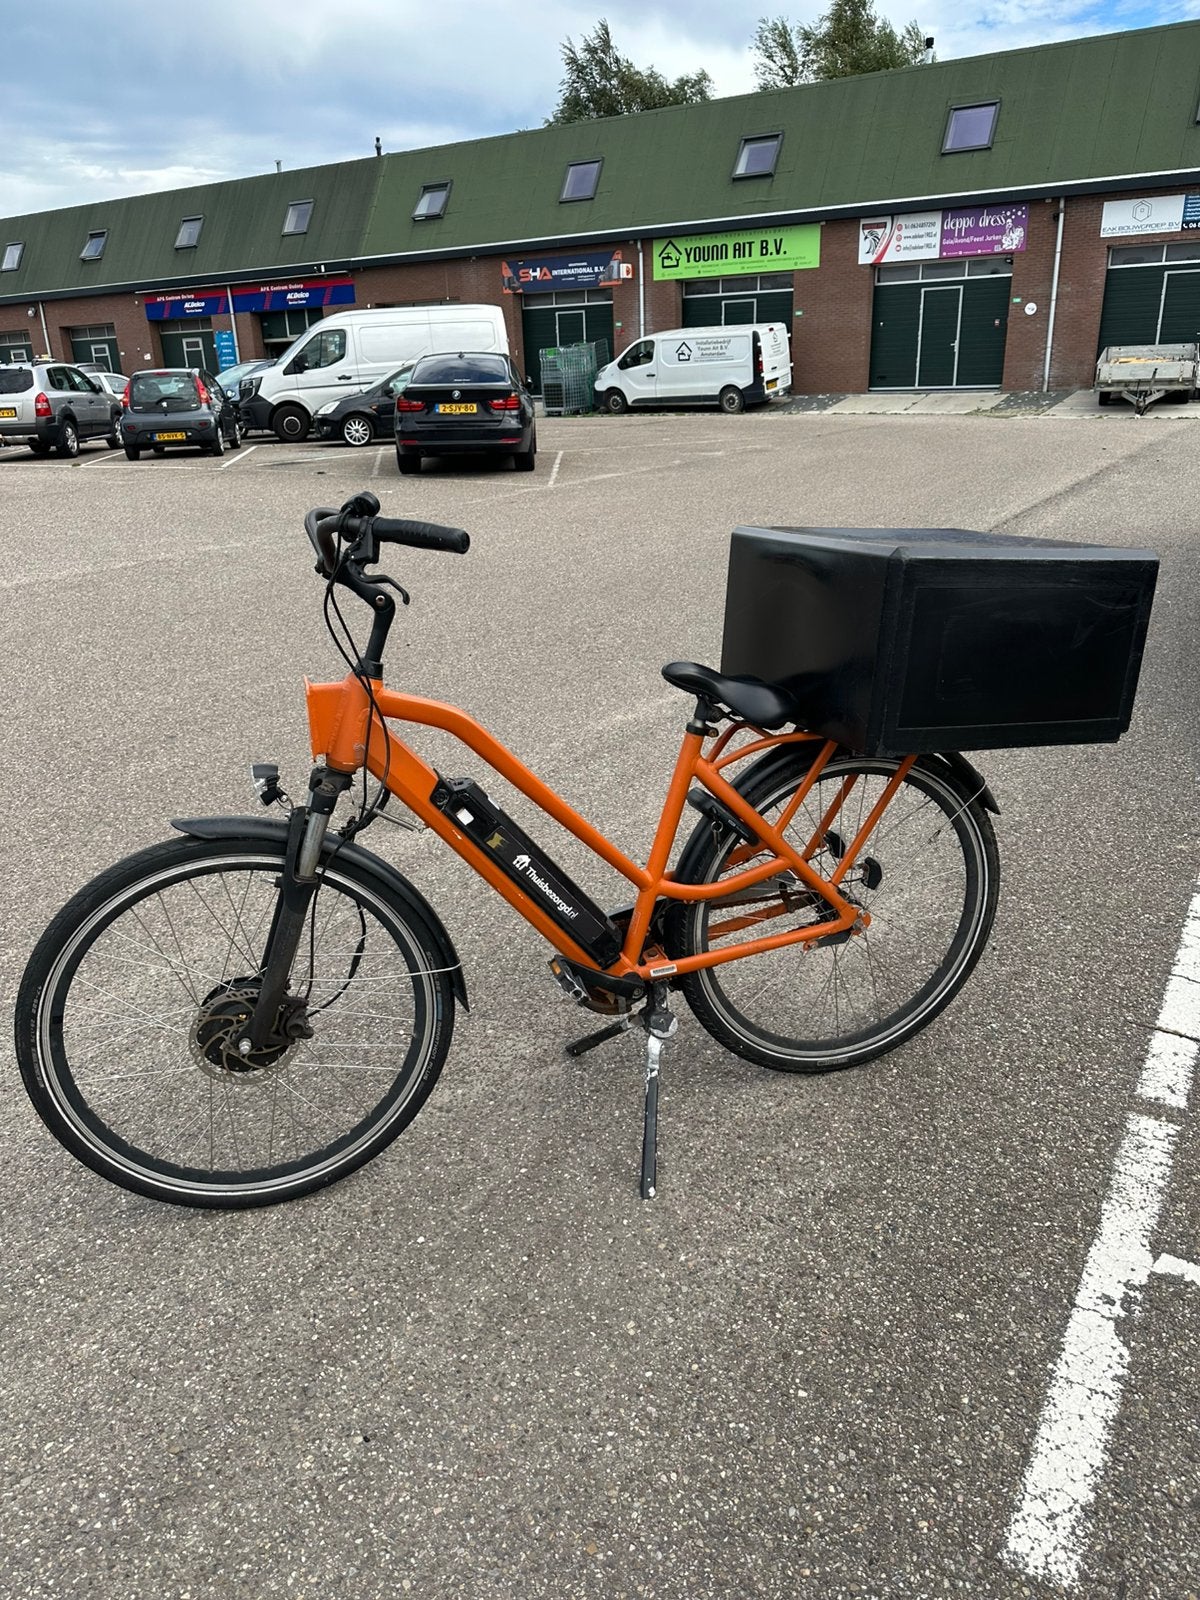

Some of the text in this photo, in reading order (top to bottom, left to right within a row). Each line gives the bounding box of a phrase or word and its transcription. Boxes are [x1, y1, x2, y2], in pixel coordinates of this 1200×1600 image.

[944, 209, 1006, 237] deppo dress
[684, 237, 787, 263] YOUNN AIT B.V.
[519, 265, 606, 282] SHA INTERNATIONAL B.V.
[526, 866, 579, 920] Thuisbezorgd.nl
